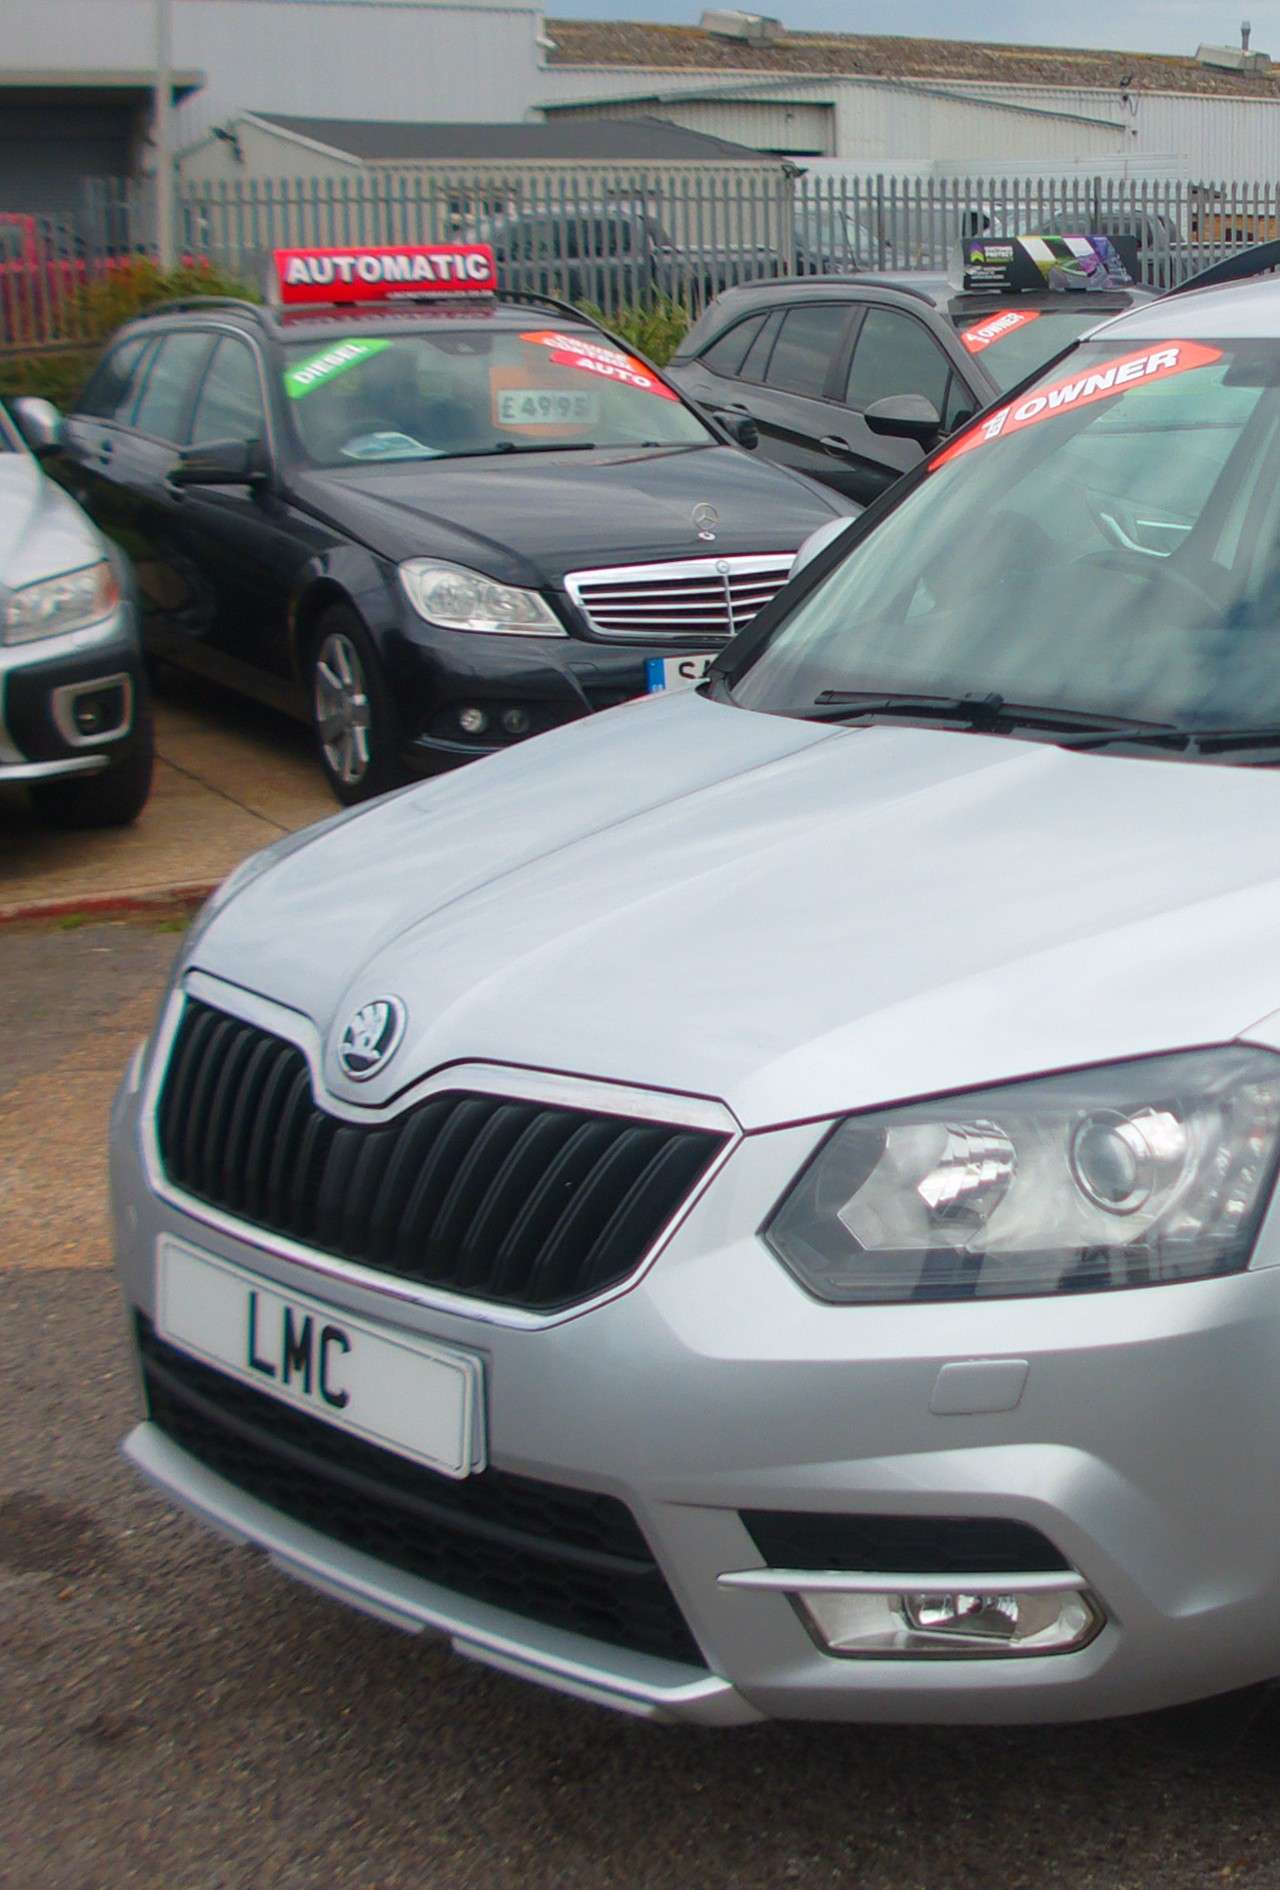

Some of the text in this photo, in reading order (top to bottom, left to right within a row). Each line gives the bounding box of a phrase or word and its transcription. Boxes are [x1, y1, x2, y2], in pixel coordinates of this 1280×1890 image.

[287, 253, 491, 284] AUTOMATIC
[576, 357, 652, 389] AUTO
[1014, 347, 1179, 422] OWNER
[249, 1292, 351, 1408] LMC
